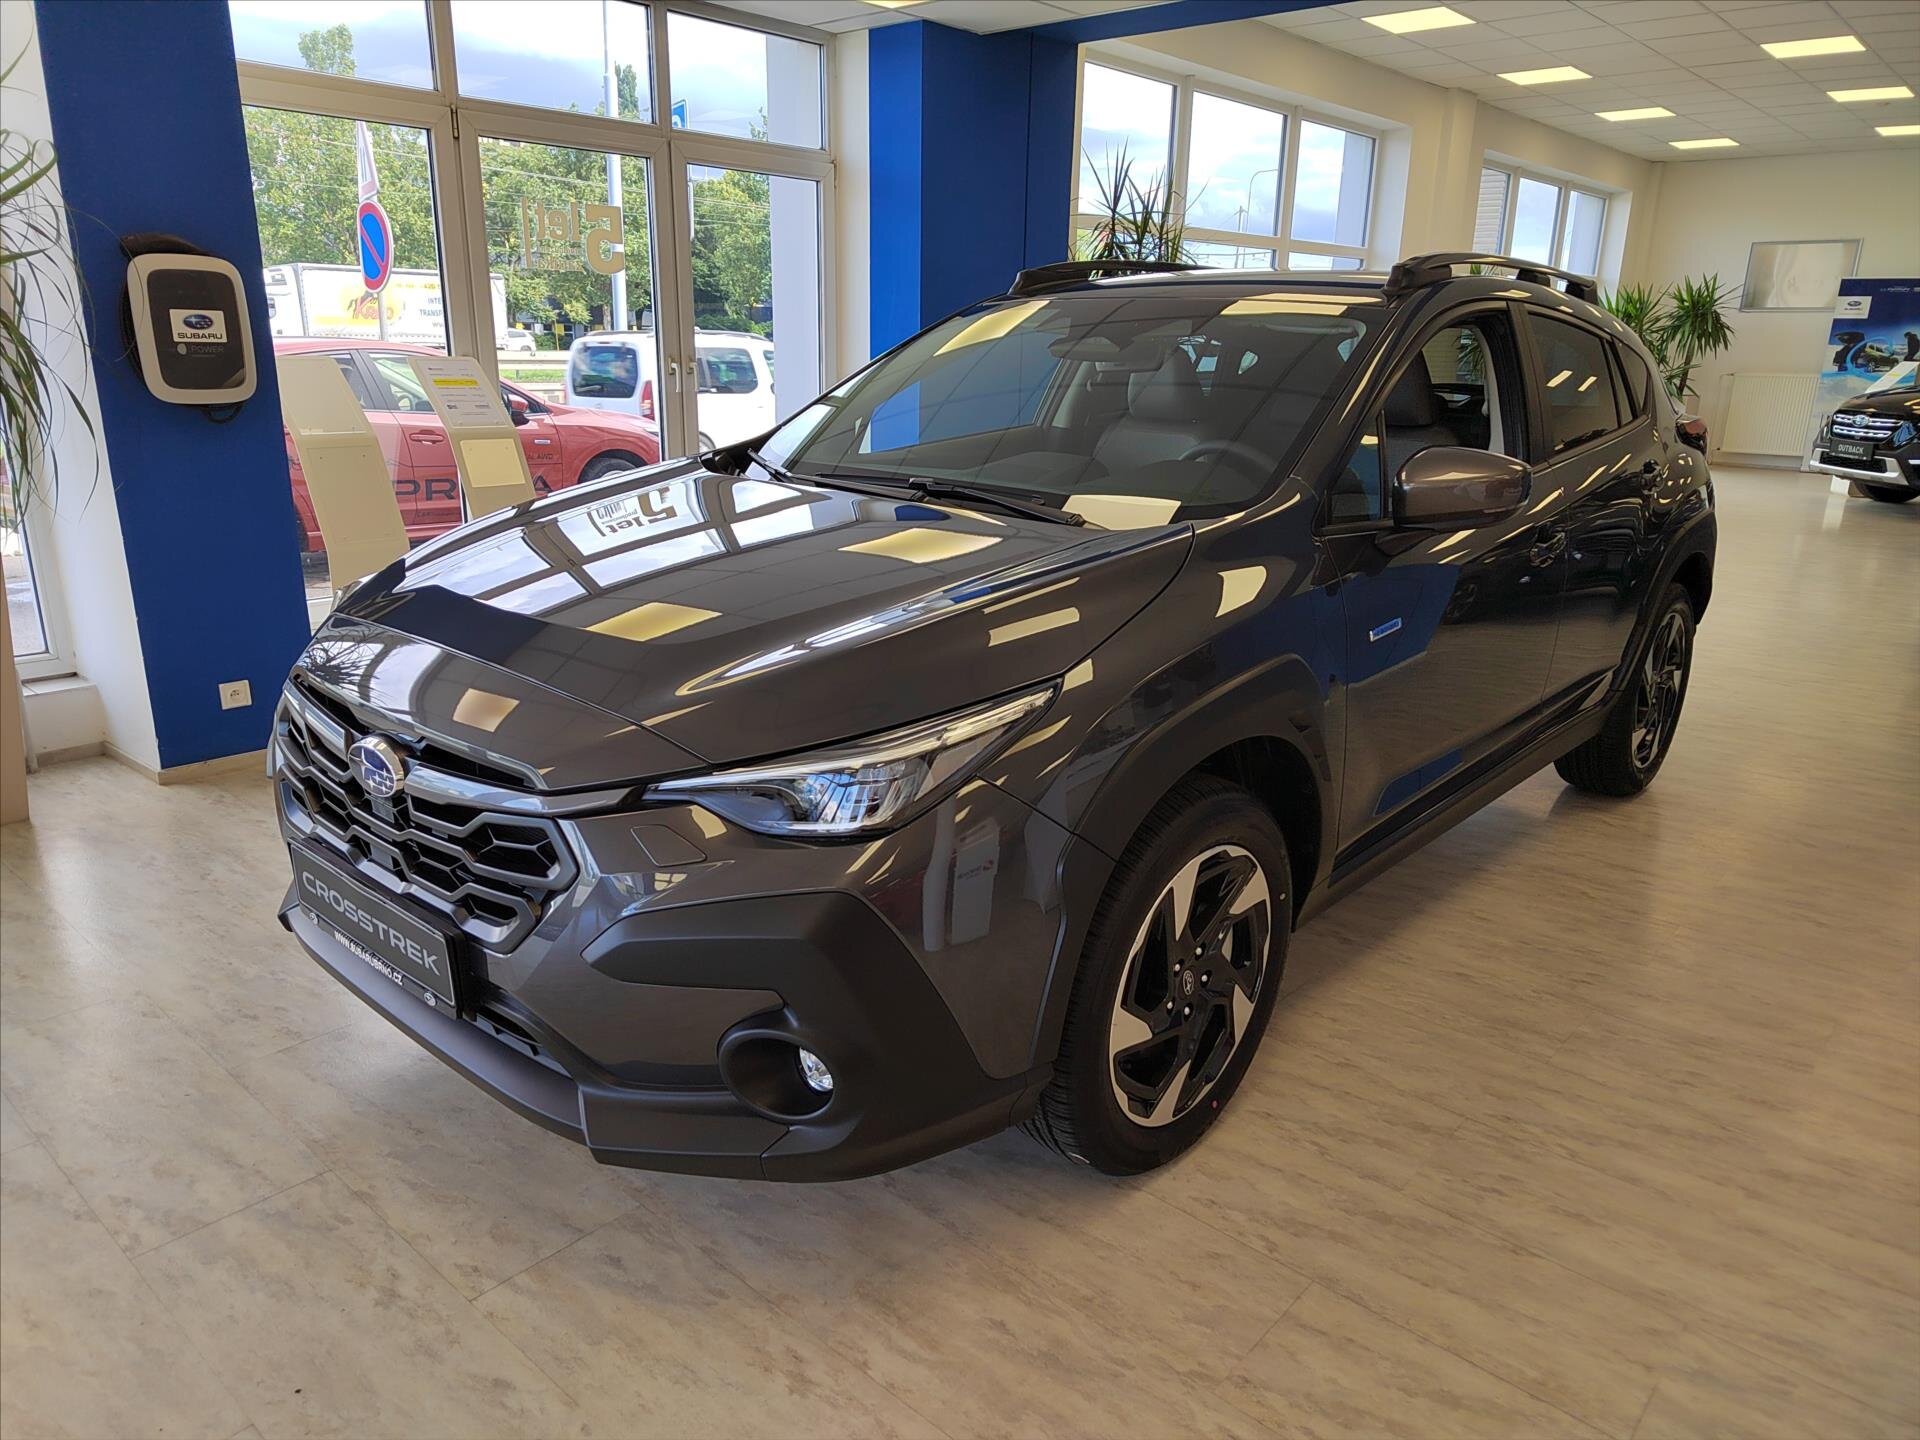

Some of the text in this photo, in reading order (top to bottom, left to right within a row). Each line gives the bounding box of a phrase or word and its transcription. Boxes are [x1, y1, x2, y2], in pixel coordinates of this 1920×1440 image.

[177, 332, 223, 340] SUBARU
[1838, 443, 1864, 454] OUTBACK
[302, 870, 441, 977] CROSSTREK
[333, 929, 404, 987] WWW.SUBARUBRNO.CZ
